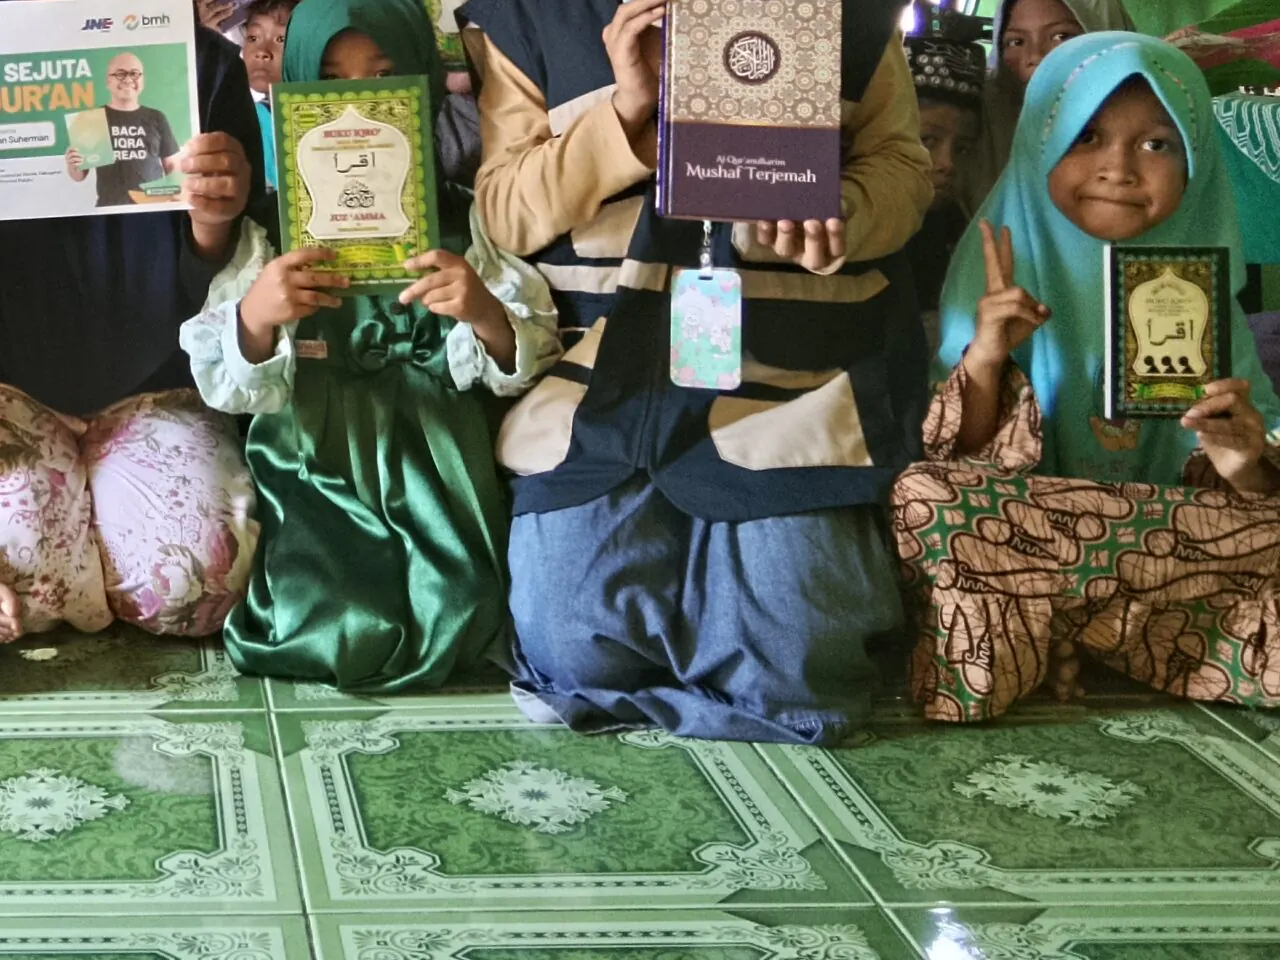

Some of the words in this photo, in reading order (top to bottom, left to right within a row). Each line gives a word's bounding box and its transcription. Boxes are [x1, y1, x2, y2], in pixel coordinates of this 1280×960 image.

[81, 18, 113, 31] JNE
[142, 14, 170, 25] bmh
[4, 58, 92, 82] SEJUTA
[111, 126, 146, 136] BACA
[9, 134, 49, 144] Suherman
[114, 138, 145, 149] IQRA
[113, 150, 147, 160] READ
[686, 163, 743, 180] Mushaf
[745, 166, 816, 184] Terjemah
